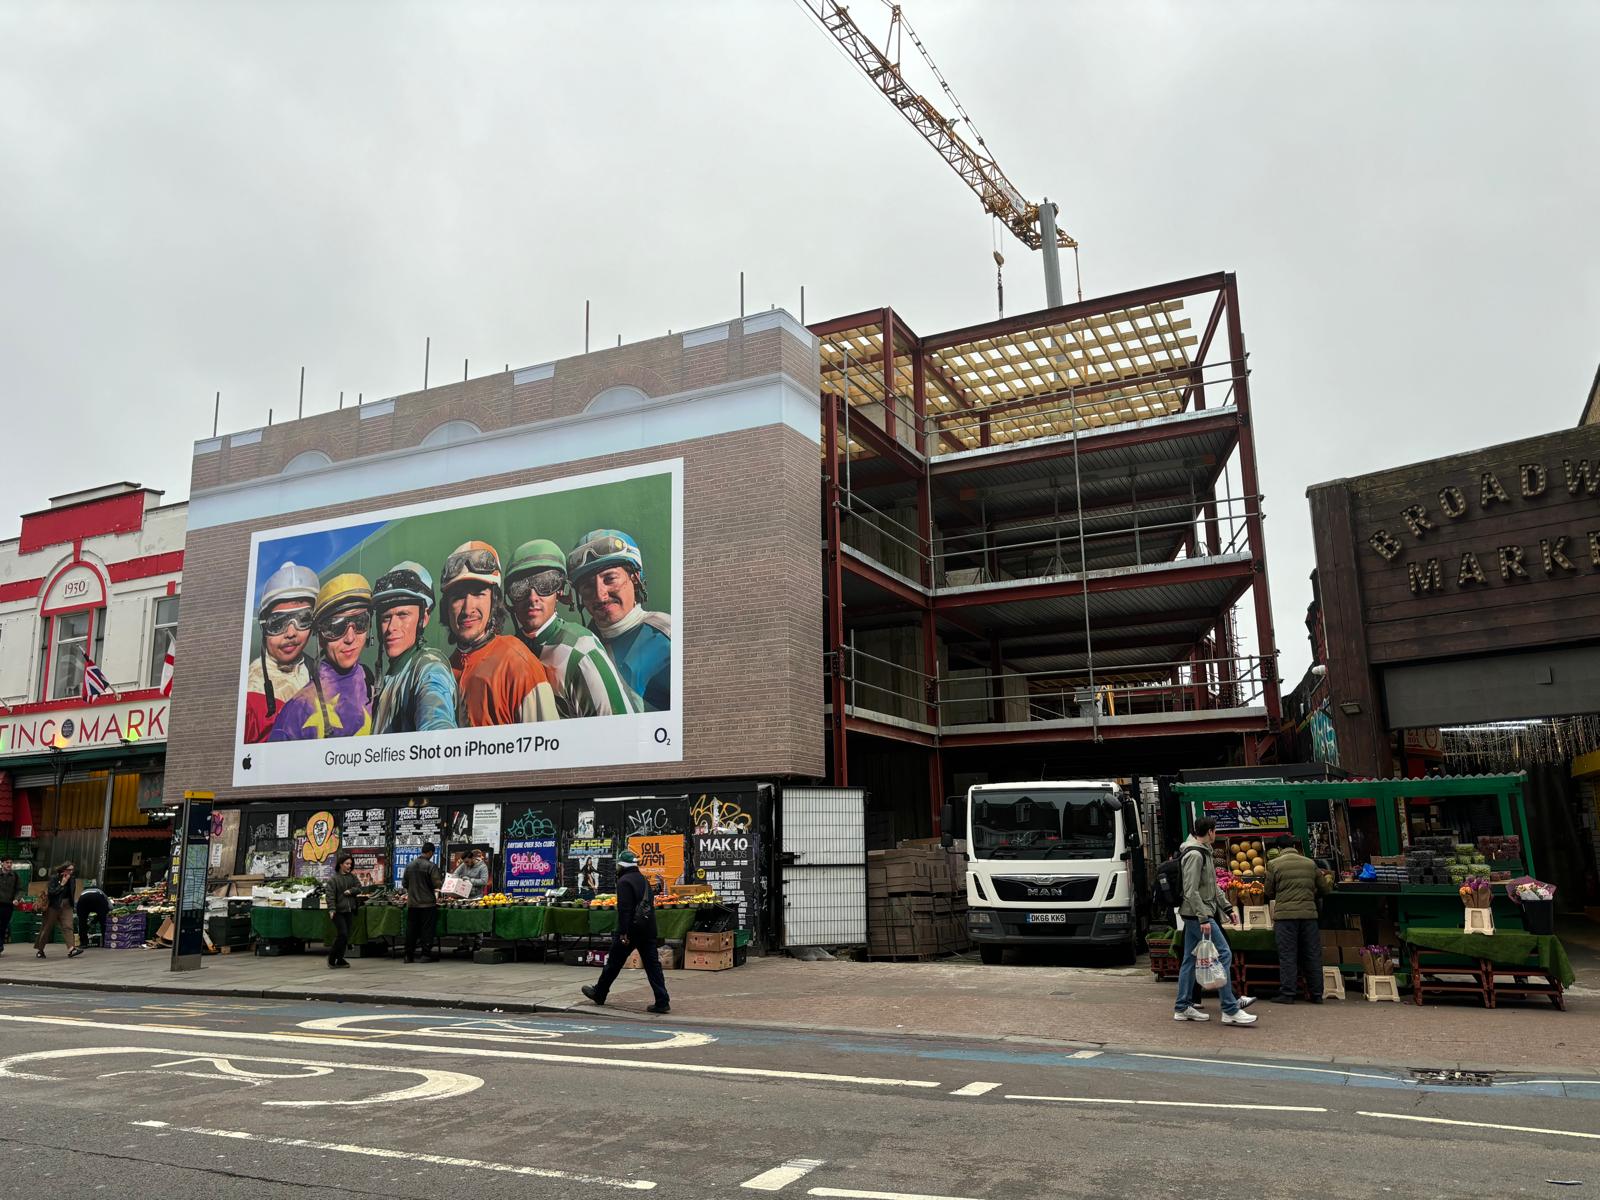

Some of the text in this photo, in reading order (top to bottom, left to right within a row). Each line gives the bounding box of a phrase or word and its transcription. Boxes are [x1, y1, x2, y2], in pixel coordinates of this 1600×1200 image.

[79, 706, 166, 743] MARK
[654, 727, 671, 746] O2
[325, 736, 560, 767] Group Selfies Shot on iPhone 17 Pro
[641, 843, 661, 855] SOUL
[700, 838, 748, 851] MAK 10
[511, 852, 542, 865] Club de
[637, 854, 665, 866] SSION
